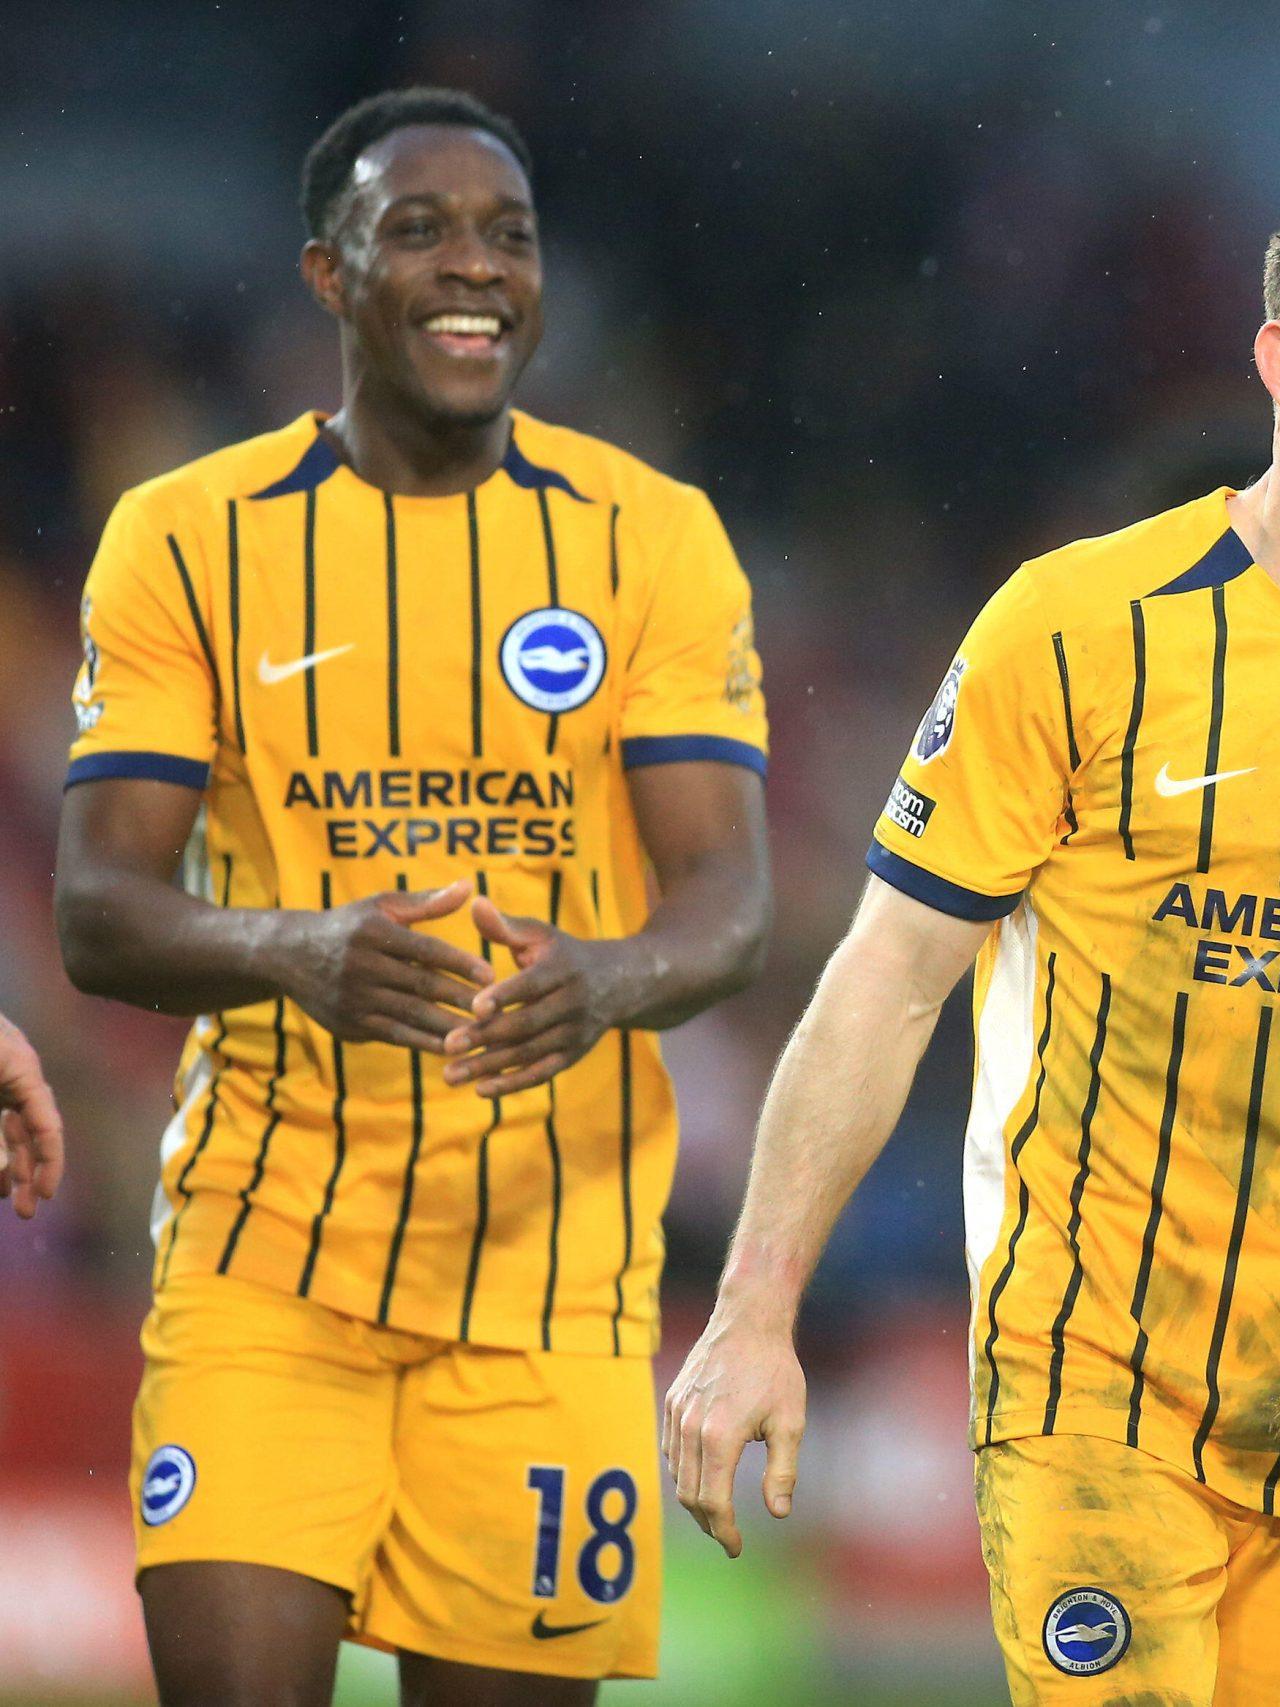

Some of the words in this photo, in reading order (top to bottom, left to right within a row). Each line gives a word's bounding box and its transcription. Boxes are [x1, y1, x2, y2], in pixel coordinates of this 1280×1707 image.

[284, 770, 574, 808] AMERICAN
[528, 1466, 637, 1605] 18
[1053, 1594, 1088, 1619] BRIGHTON
[1100, 1599, 1118, 1615] HOVE
[1069, 1660, 1101, 1670] ALBION
